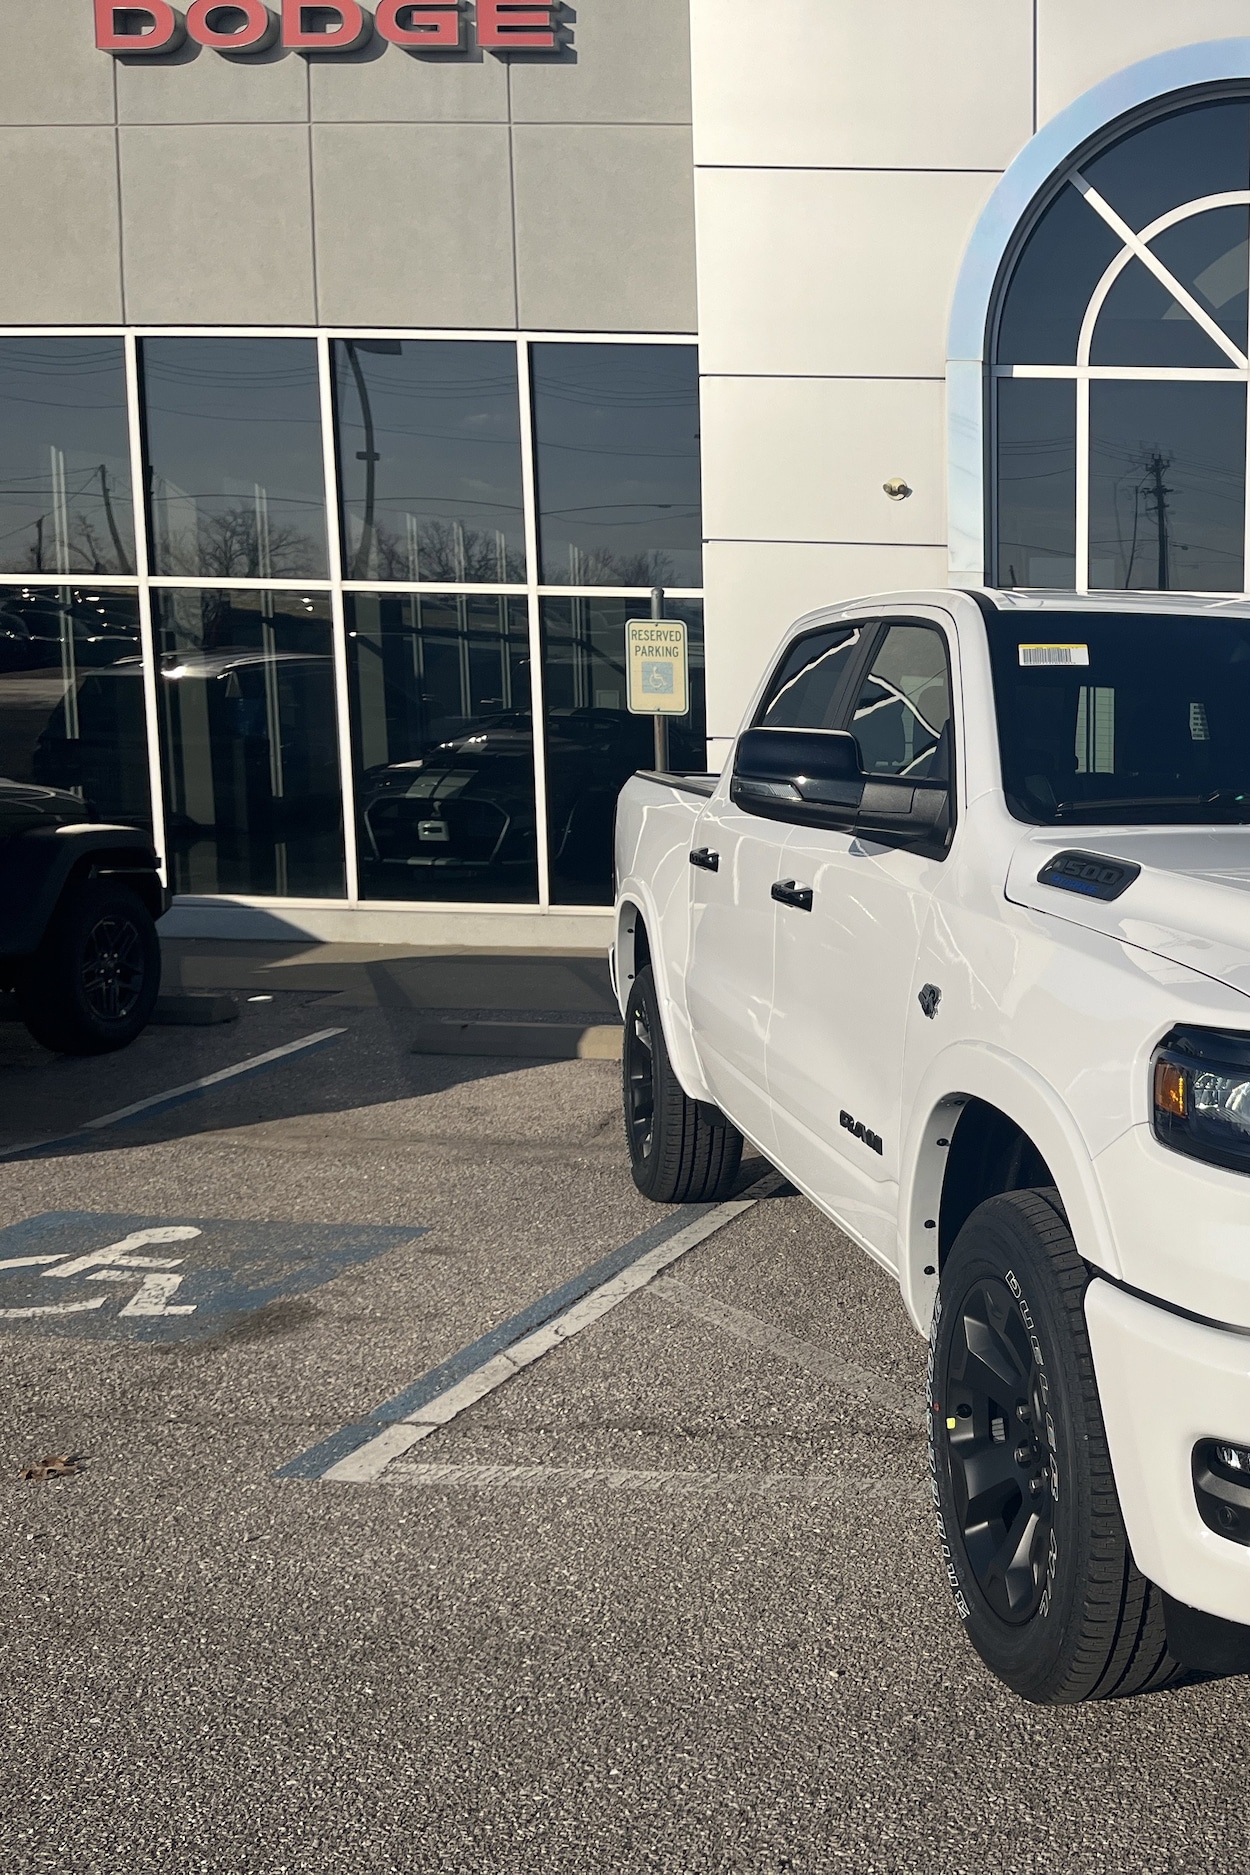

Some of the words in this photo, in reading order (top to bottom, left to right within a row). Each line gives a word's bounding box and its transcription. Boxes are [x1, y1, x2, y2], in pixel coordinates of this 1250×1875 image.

[95, 0, 561, 52] DODGE
[631, 629, 682, 642] RESERVED
[634, 645, 679, 658] PARKING
[839, 1109, 883, 1156] RAM
